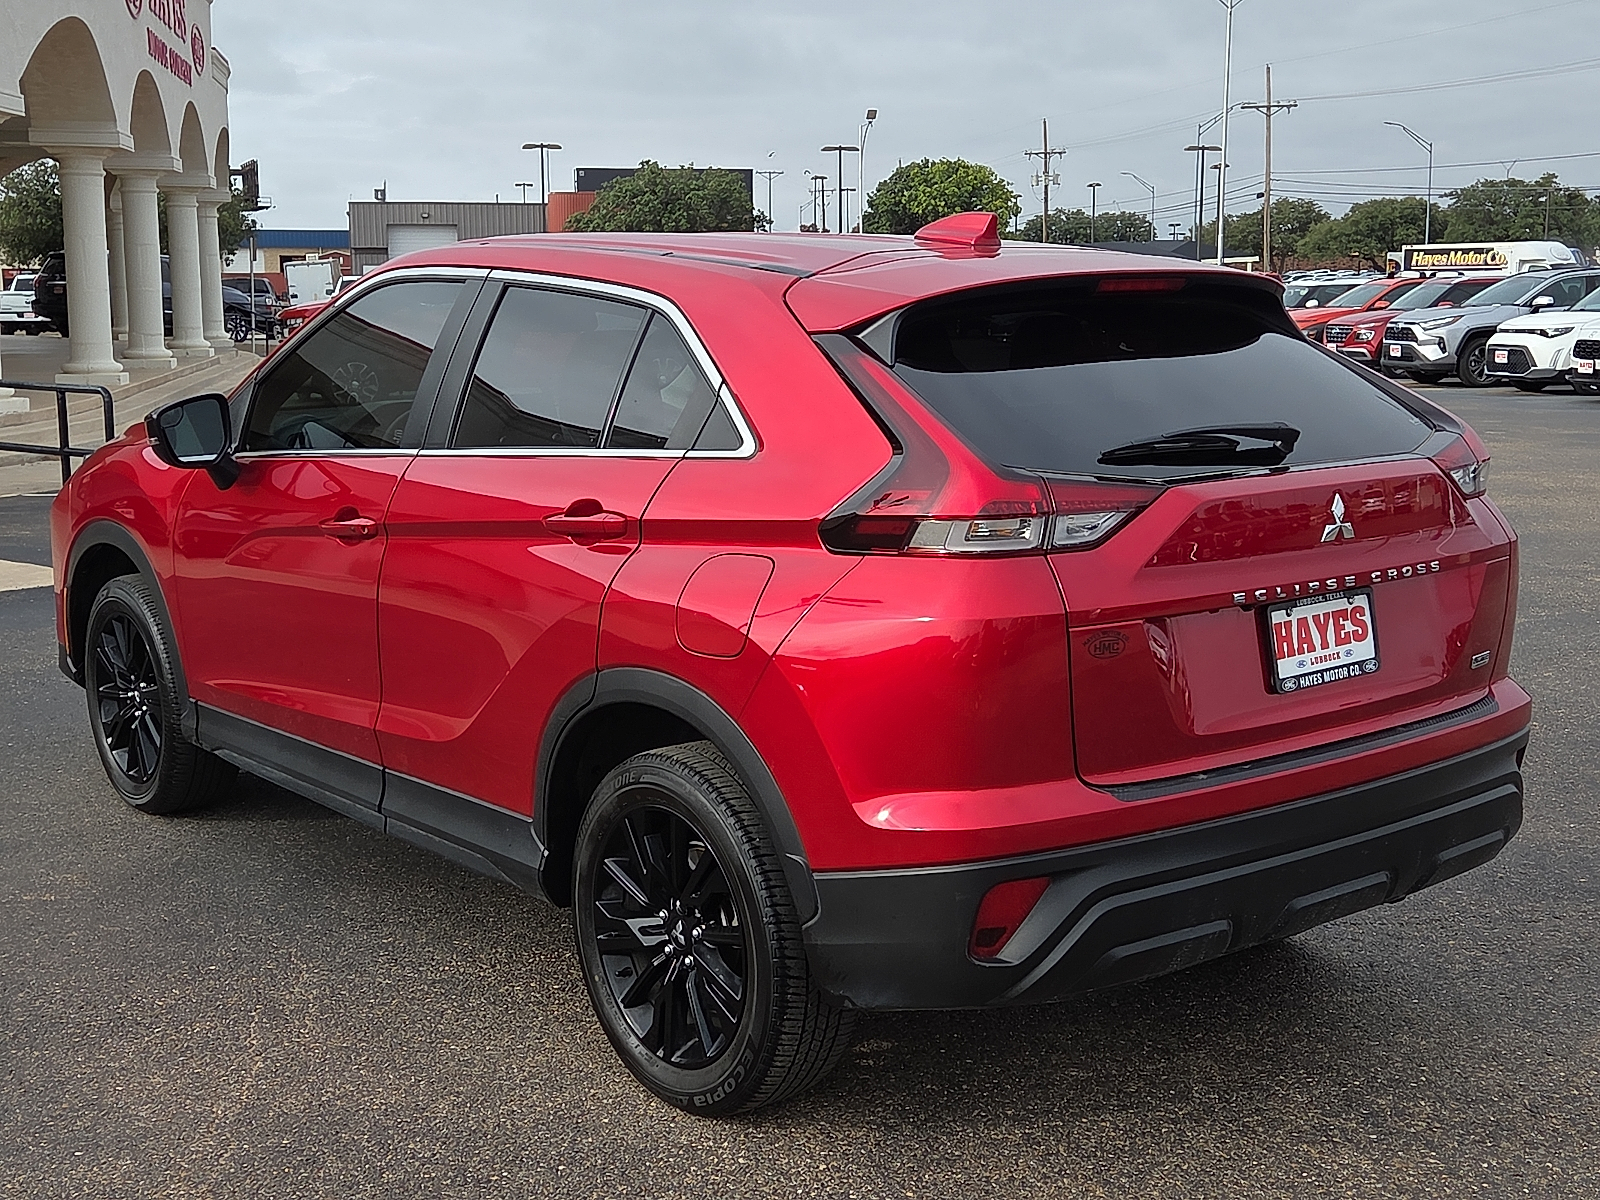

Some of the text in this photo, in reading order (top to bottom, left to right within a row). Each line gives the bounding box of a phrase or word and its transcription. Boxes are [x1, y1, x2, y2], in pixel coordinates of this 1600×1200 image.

[1411, 251, 1448, 270] Hayes
[1448, 250, 1487, 266] Motor
[1486, 249, 1508, 266] Co.
[1232, 560, 1440, 605] ECLIPSE CROSS
[1326, 591, 1345, 600] TEXAS
[1273, 605, 1369, 661] HAYES
[1093, 638, 1120, 656] HMC
[1310, 651, 1342, 666] LUBBOCK
[1300, 672, 1322, 688] HAYES
[1323, 667, 1348, 682] MOTOR
[1349, 664, 1362, 677] CO.
